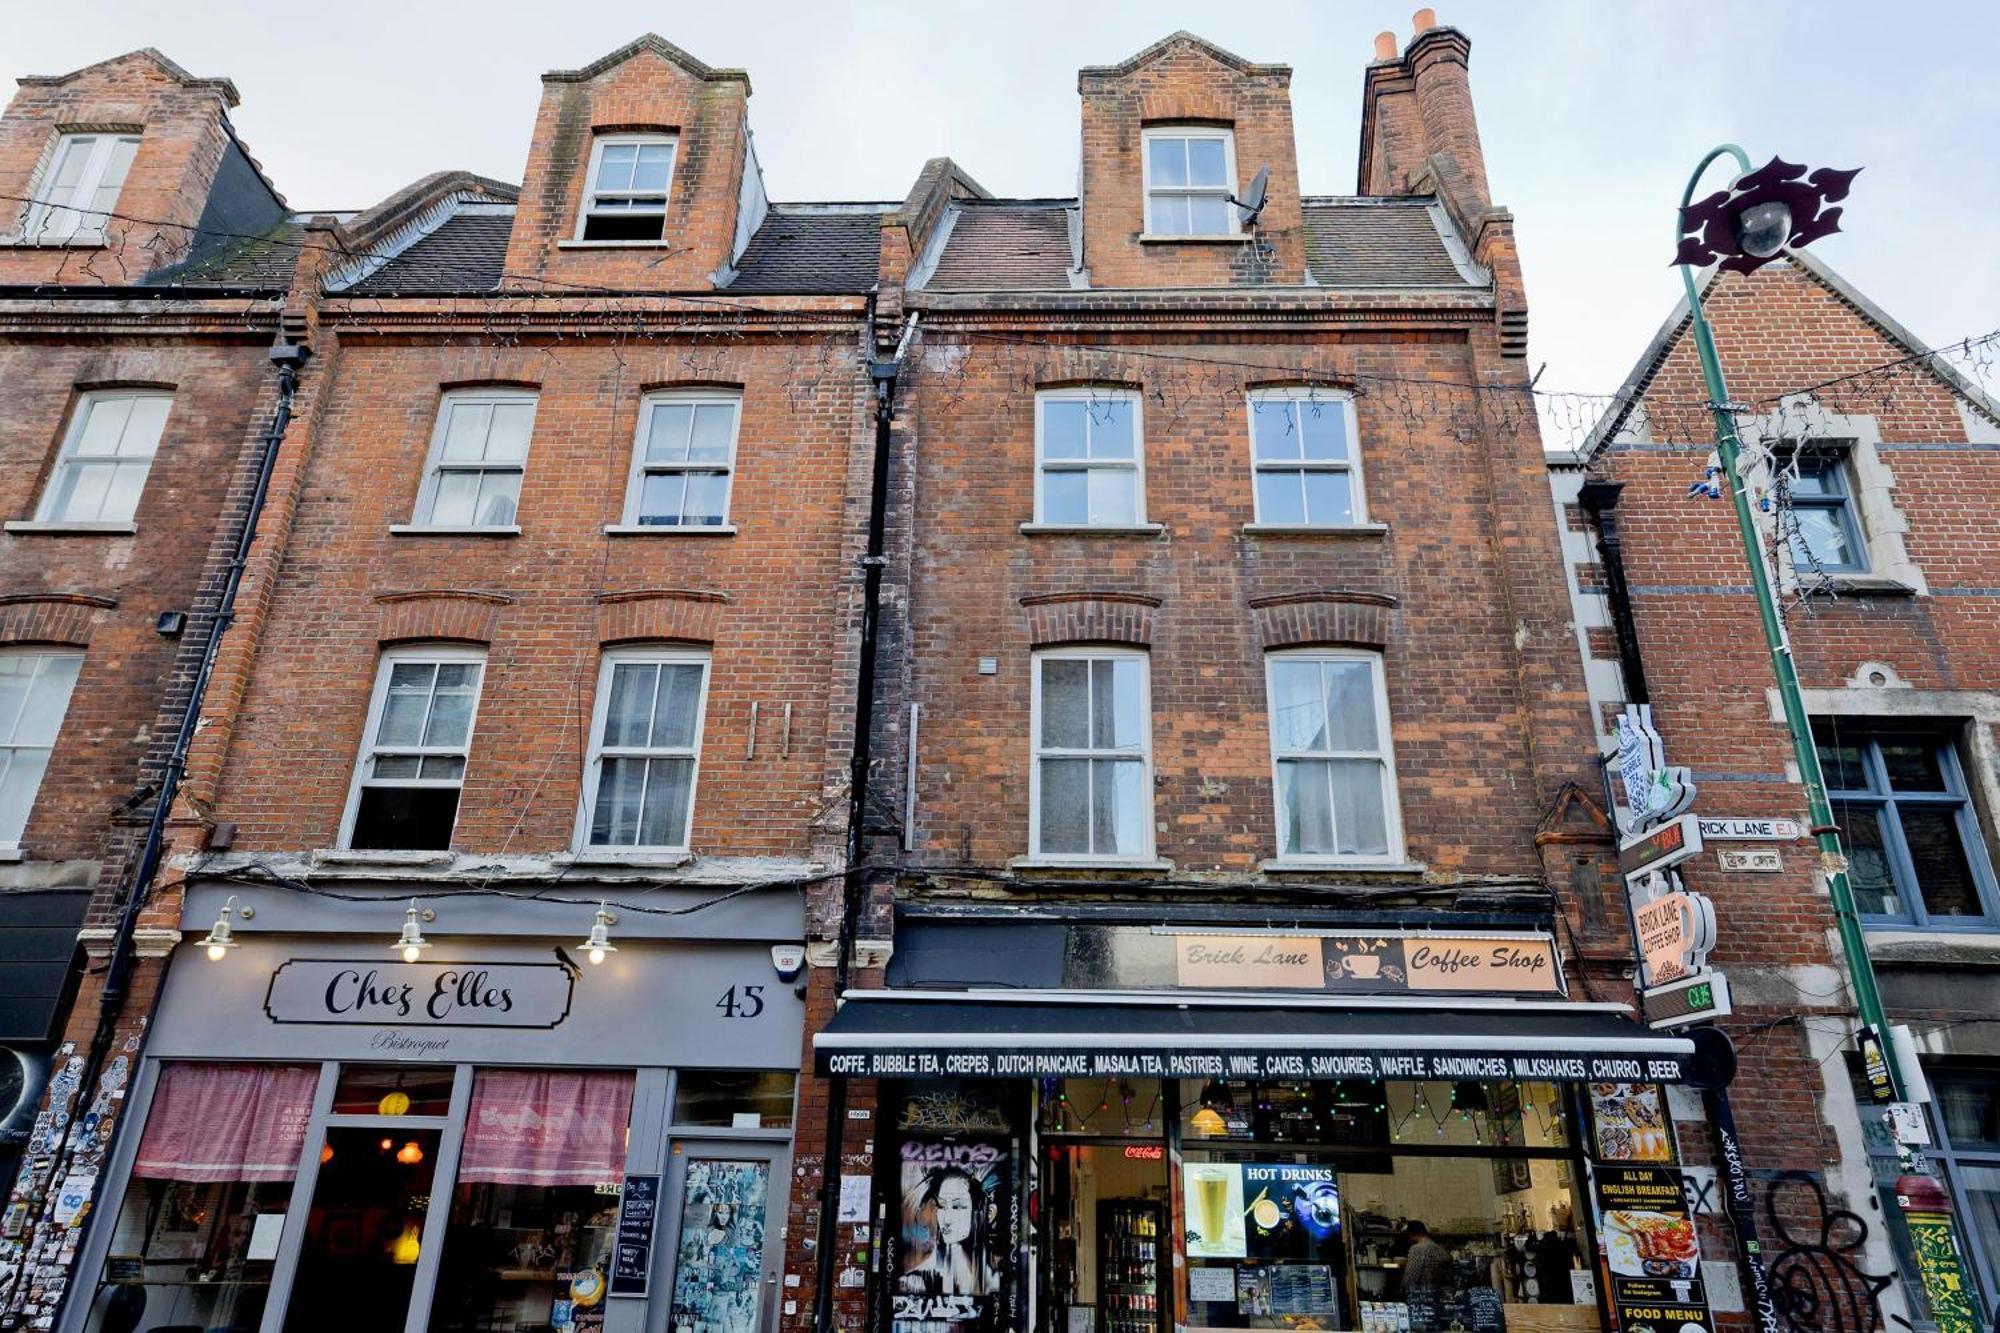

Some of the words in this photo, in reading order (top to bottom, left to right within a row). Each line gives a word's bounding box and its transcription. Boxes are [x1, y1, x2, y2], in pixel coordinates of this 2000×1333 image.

[1700, 823, 1728, 836] RICK
[1734, 823, 1772, 836] LANE
[1638, 910, 1659, 935] BRICK
[1659, 900, 1680, 927] LANE
[1643, 932, 1665, 955] COFFEE
[1664, 926, 1681, 949] SHOP
[1187, 944, 1245, 965] Brick
[1252, 945, 1309, 965] Lane
[1411, 946, 1481, 972] Coffee
[1490, 947, 1546, 973] Shop
[325, 969, 412, 1018] Chez
[426, 970, 513, 1020] Elles
[715, 984, 765, 1018] 45
[371, 1031, 450, 1056] Bistroquet
[830, 1055, 865, 1072] COFFE
[873, 1055, 915, 1072] BUBBLE
[918, 1055, 938, 1072] TEA
[946, 1055, 988, 1073] CREPES
[998, 1056, 1033, 1073] DUTCH
[1035, 1056, 1087, 1073] PANCAKE
[1095, 1056, 1140, 1073] MASALA
[1141, 1056, 1163, 1073] TEA
[1171, 1056, 1222, 1073] PASTRIES
[1230, 1056, 1258, 1073] WINE
[1266, 1057, 1304, 1074] CAKES
[1311, 1057, 1373, 1074] SAVOURIES
[1380, 1057, 1425, 1075] WAFFLE
[1433, 1058, 1507, 1076] SANDWICHES
[1513, 1059, 1585, 1077] MILKSHAKES
[1592, 1060, 1640, 1078] CHURRO
[1648, 1061, 1681, 1079] BEER
[1247, 1168, 1277, 1181] HOT
[1281, 1169, 1333, 1181] DRINKS
[1623, 1171, 1638, 1181] ALL
[1638, 1171, 1653, 1182] DAY
[1602, 1184, 1635, 1196] ENGLISH
[1637, 1185, 1680, 1197] BREAKFAST
[1625, 1308, 1661, 1320] FOOD
[1664, 1309, 1704, 1321] MENU
